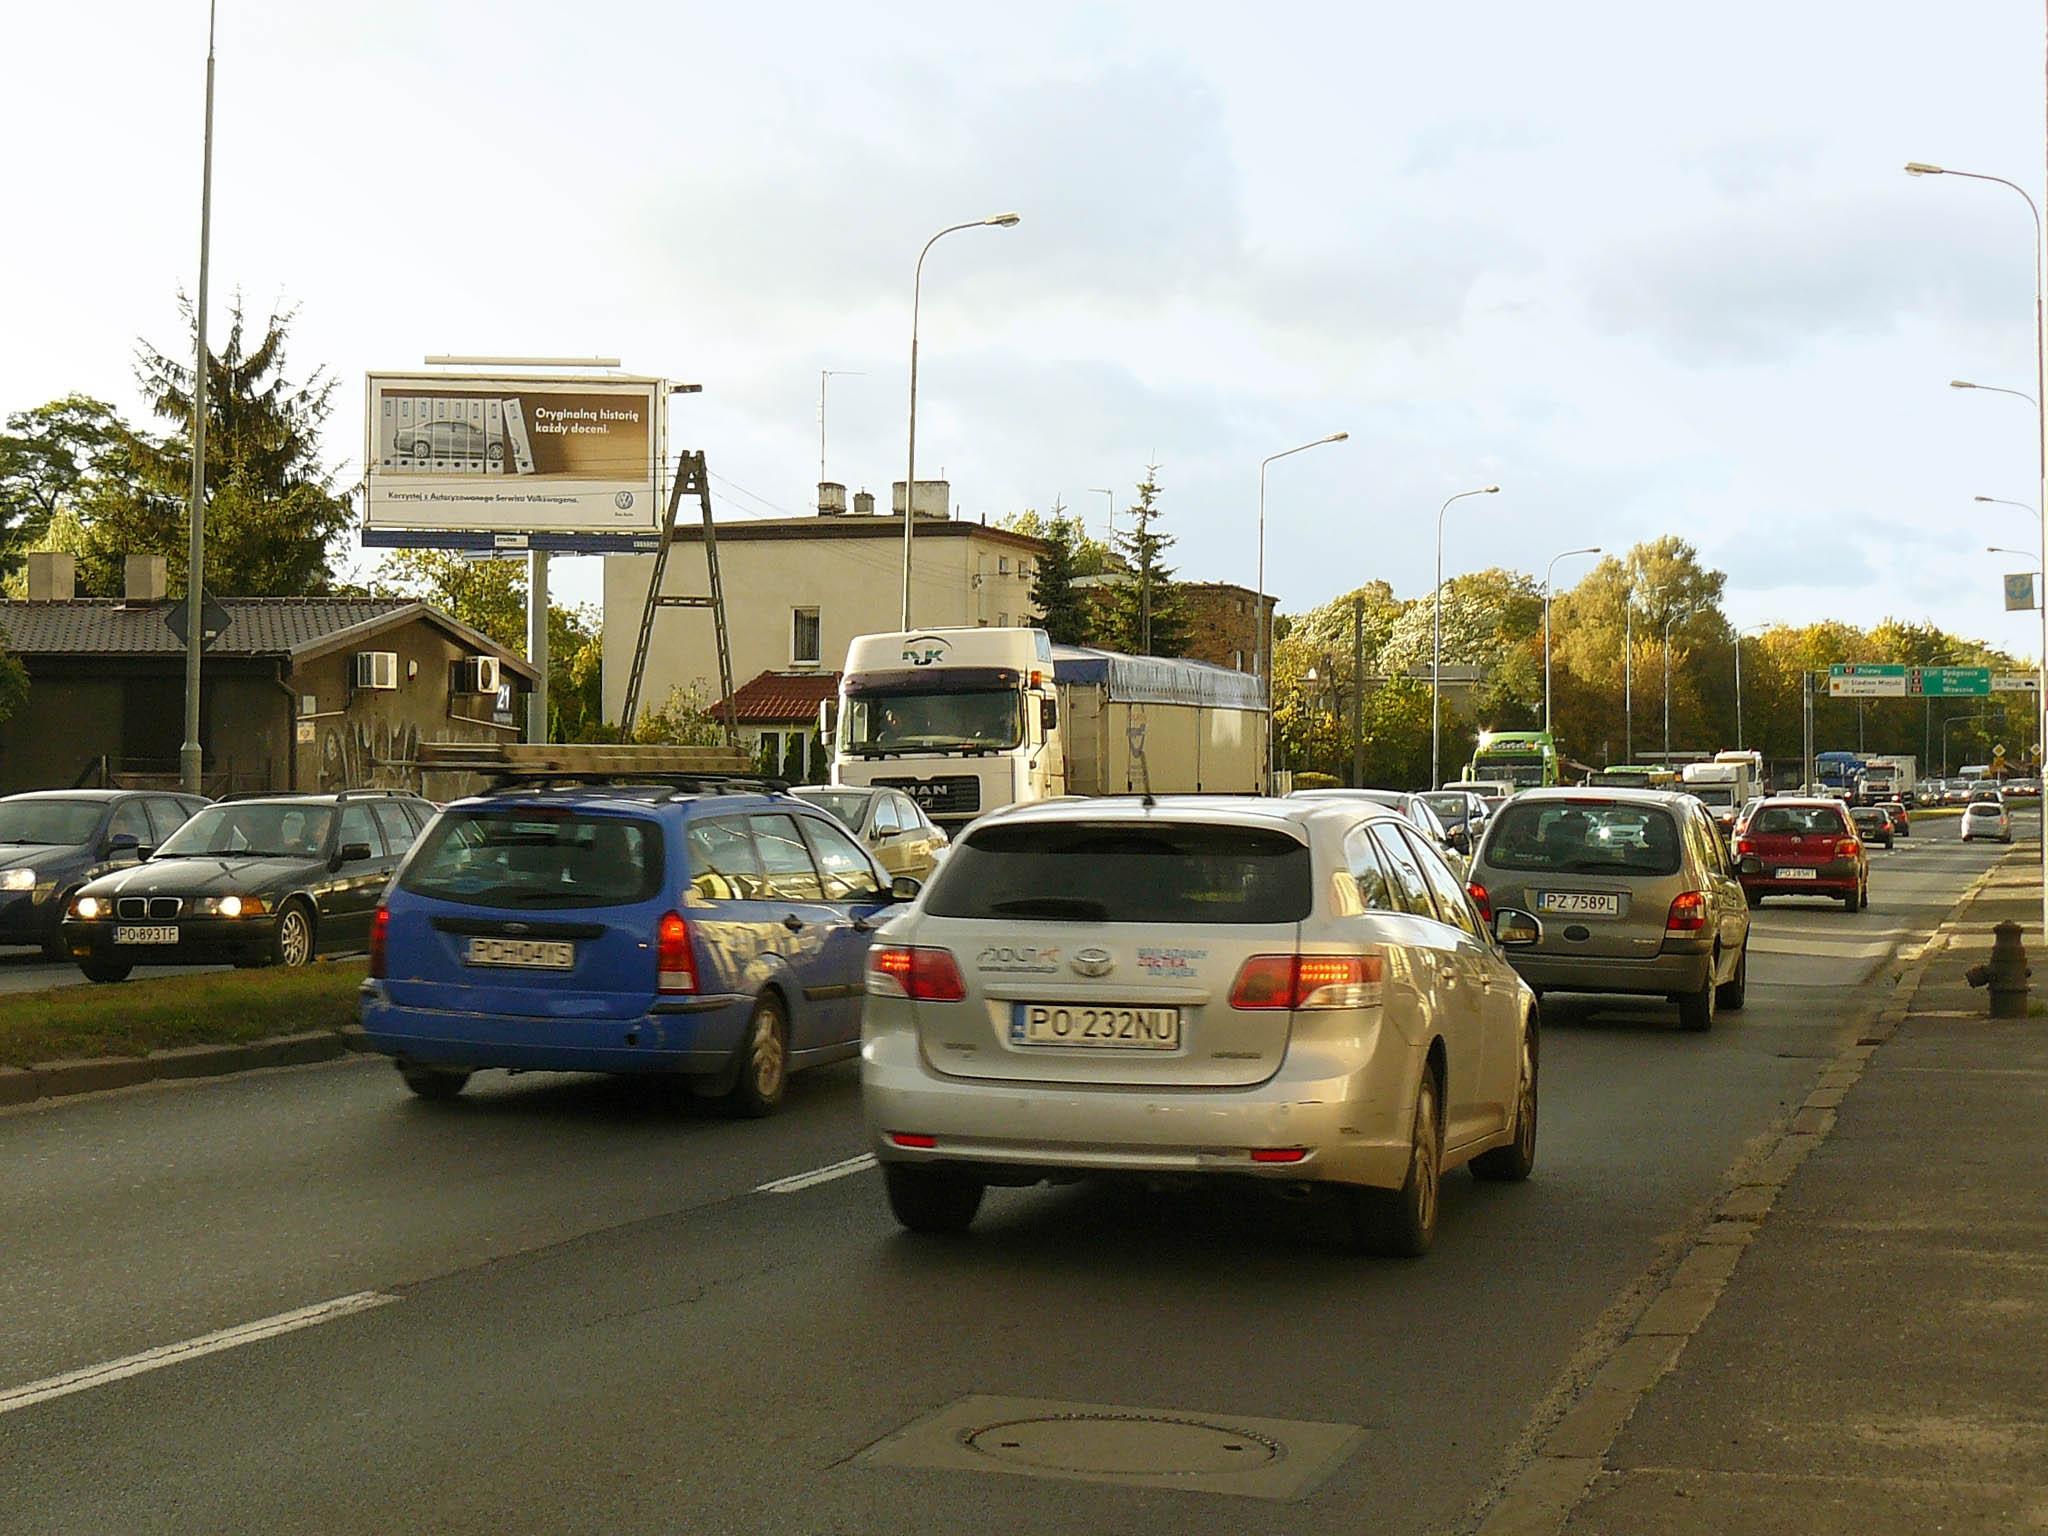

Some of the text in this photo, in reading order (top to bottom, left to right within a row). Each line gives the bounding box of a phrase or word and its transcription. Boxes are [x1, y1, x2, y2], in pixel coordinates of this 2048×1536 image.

[535, 408, 639, 422] Oryginalną historię
[535, 422, 610, 435] każdy doceni.
[496, 685, 510, 710] 21
[901, 785, 948, 796] MAN
[1546, 894, 1614, 911] PZ 7589L
[119, 927, 177, 940] PO 893TF
[1030, 1008, 1172, 1039] PO 232NU
